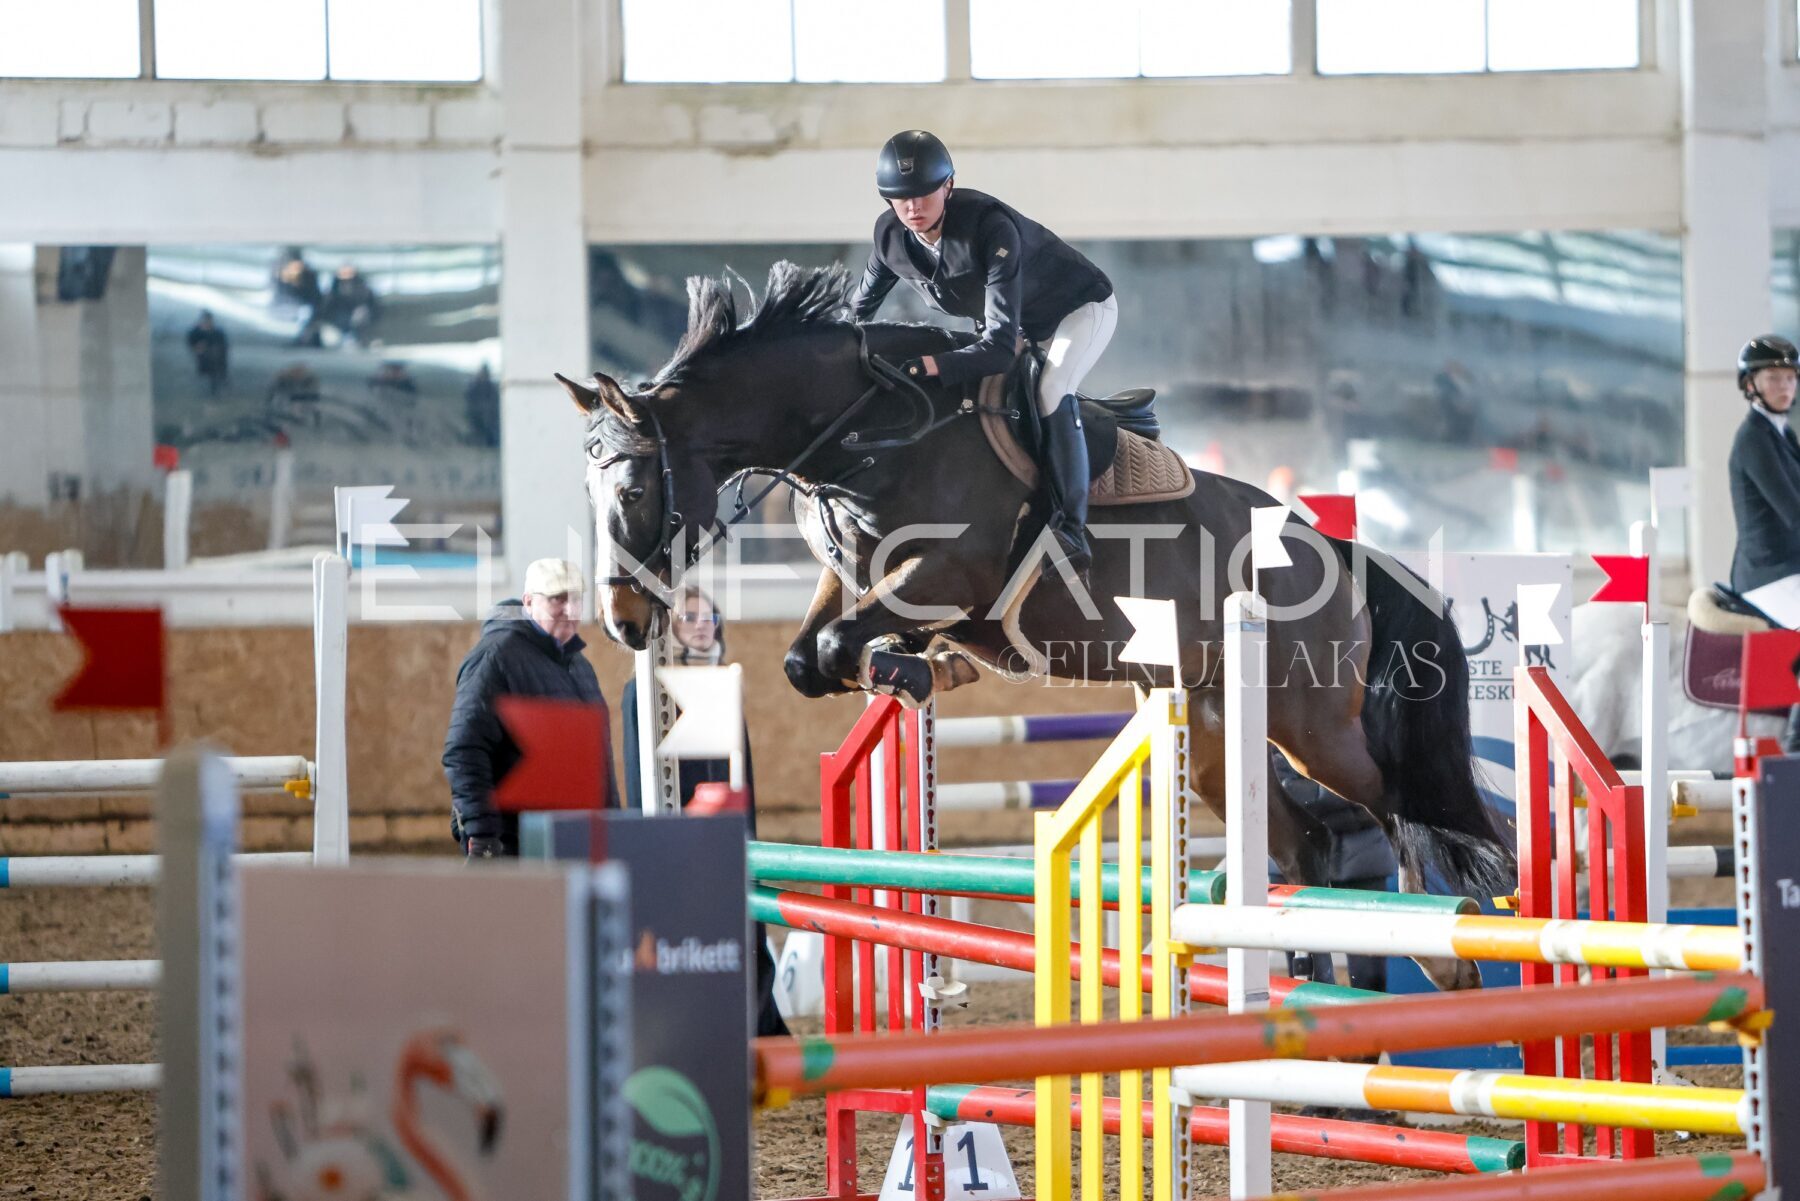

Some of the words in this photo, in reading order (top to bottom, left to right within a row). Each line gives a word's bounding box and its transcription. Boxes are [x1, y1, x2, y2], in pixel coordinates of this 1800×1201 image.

[1468, 660, 1503, 676] STE
[1468, 684, 1515, 700] ESK
[957, 1131, 989, 1191] 1
